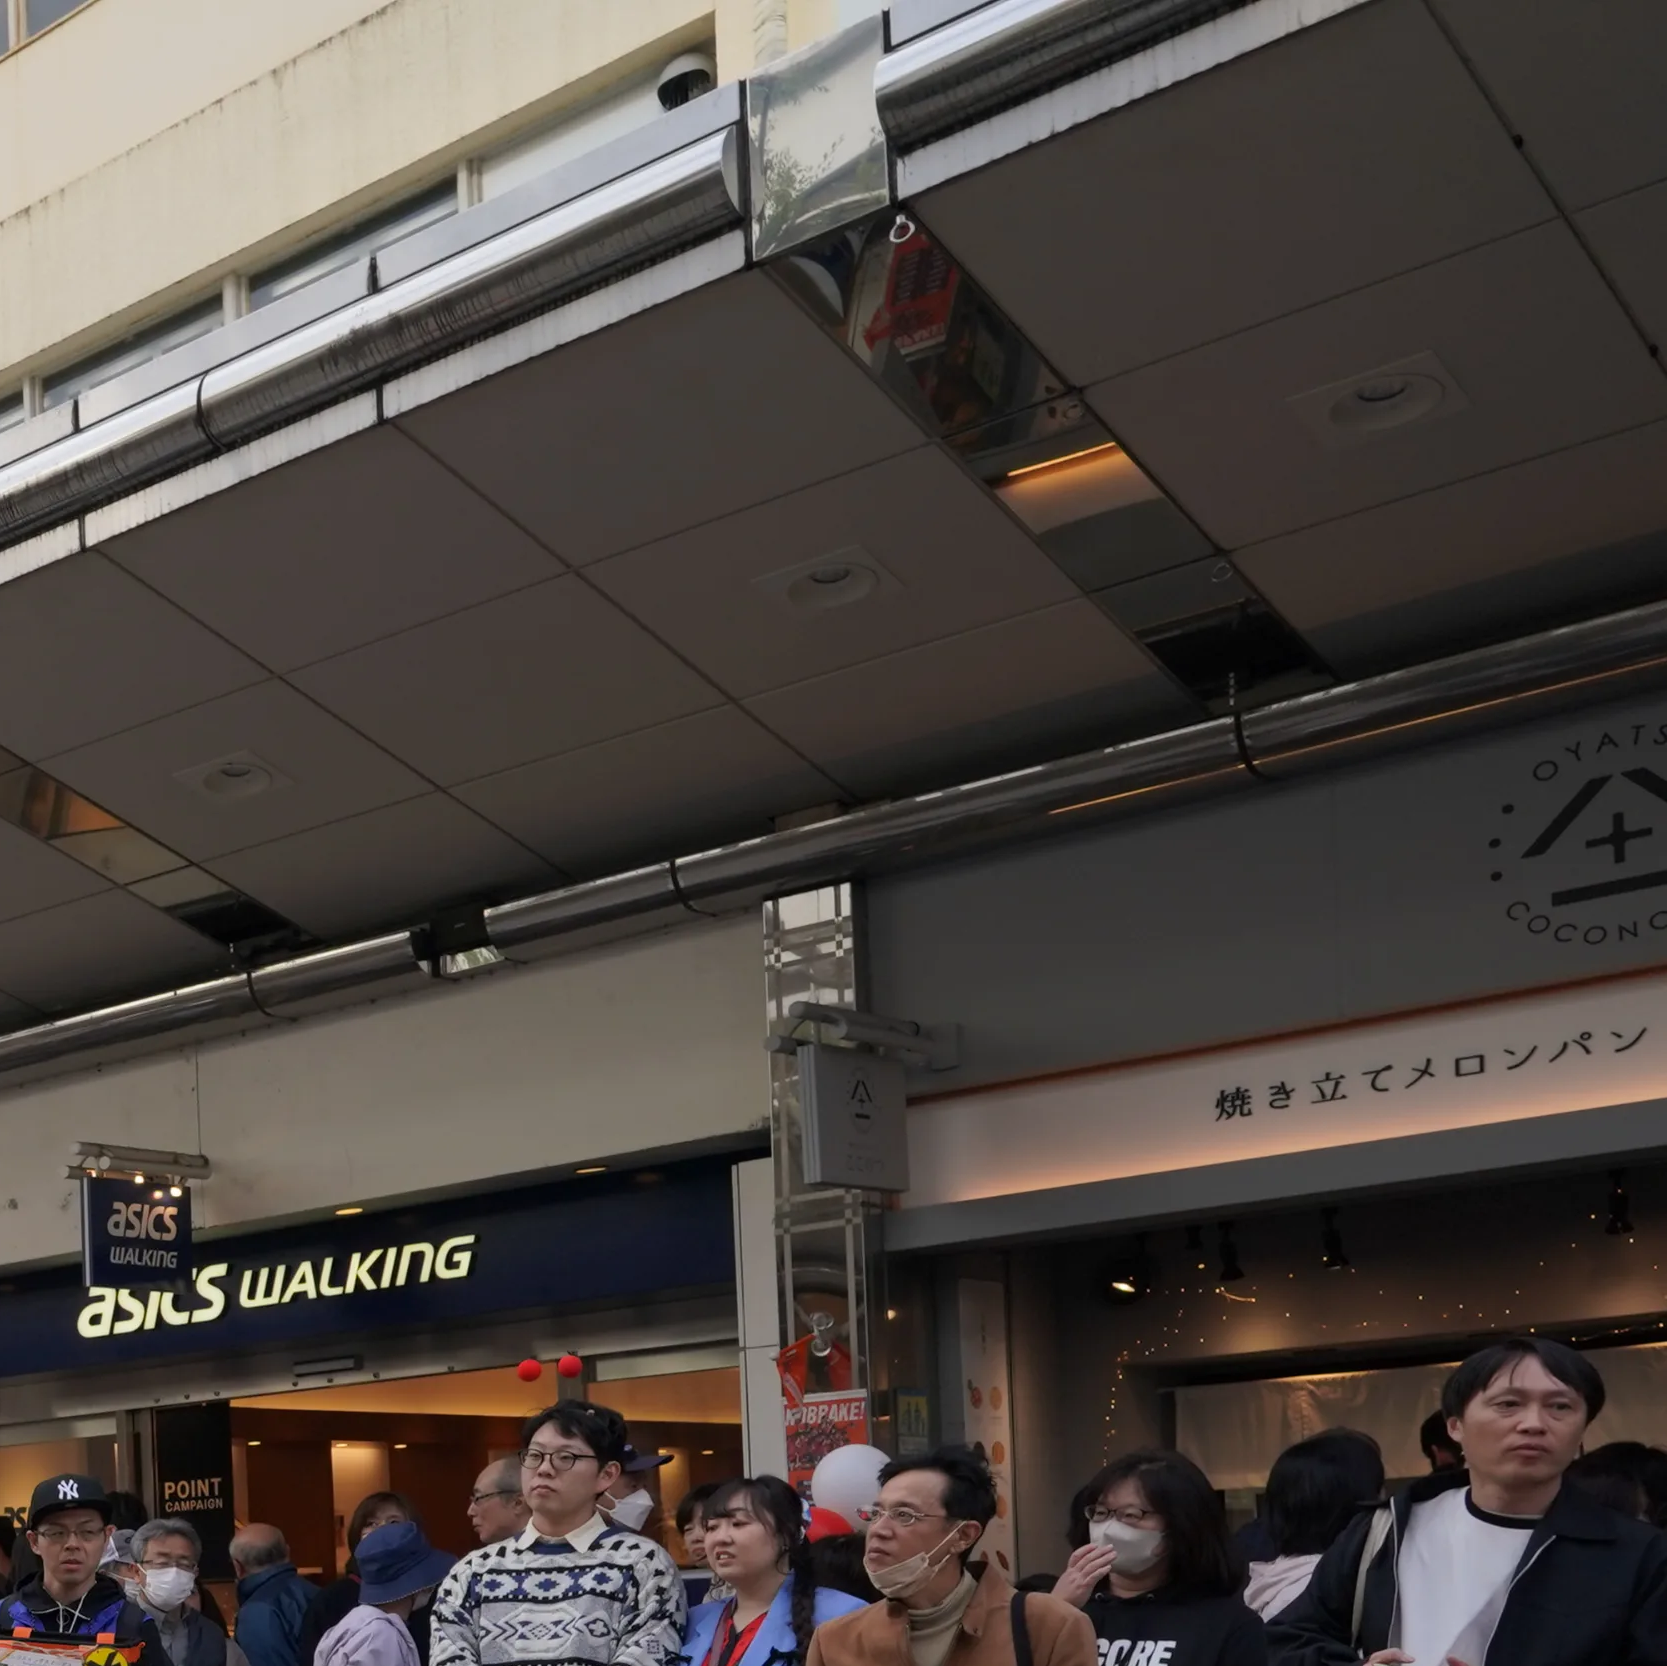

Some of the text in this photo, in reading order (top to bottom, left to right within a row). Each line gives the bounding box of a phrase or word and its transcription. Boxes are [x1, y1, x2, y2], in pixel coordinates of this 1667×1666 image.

[1215, 1026, 1648, 1122] 焼き立てメロンパン
[109, 1247, 178, 1269] WALKING
[239, 1234, 476, 1309] WALKING
[163, 1478, 222, 1500] POINT
[165, 1498, 223, 1512] CAMPAIGN
